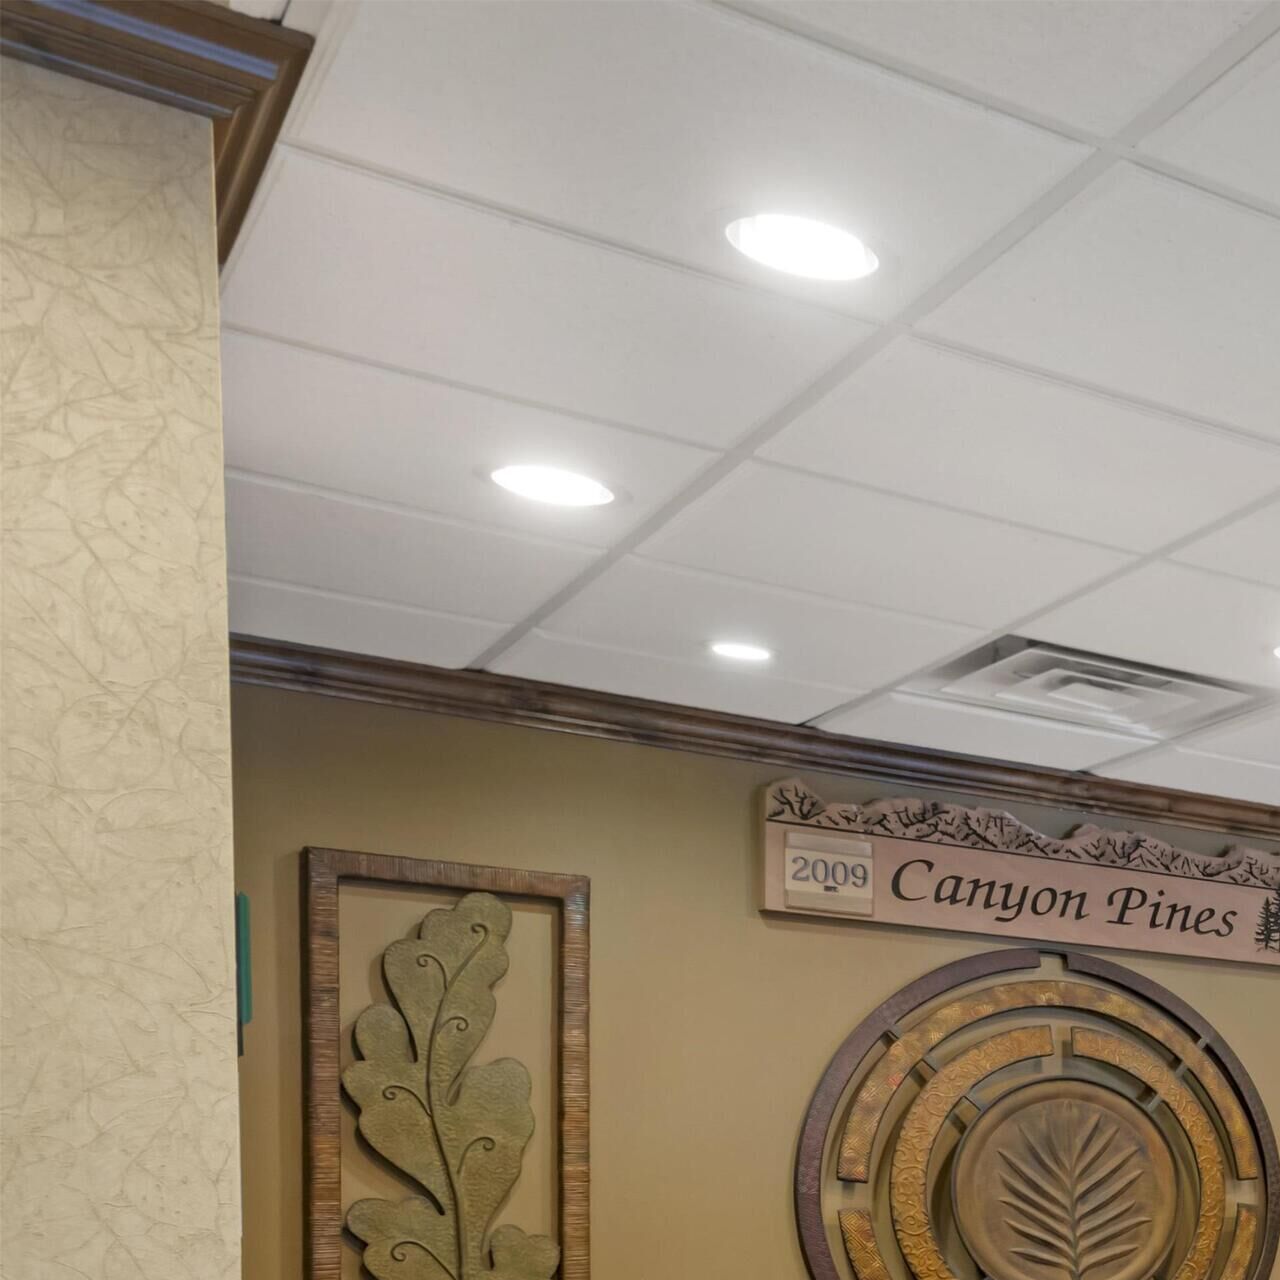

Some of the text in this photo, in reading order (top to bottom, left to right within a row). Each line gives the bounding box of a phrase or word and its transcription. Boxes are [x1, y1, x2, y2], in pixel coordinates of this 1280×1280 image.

[791, 856, 868, 888] 2009
[890, 859, 1239, 937] Canyon Pines
